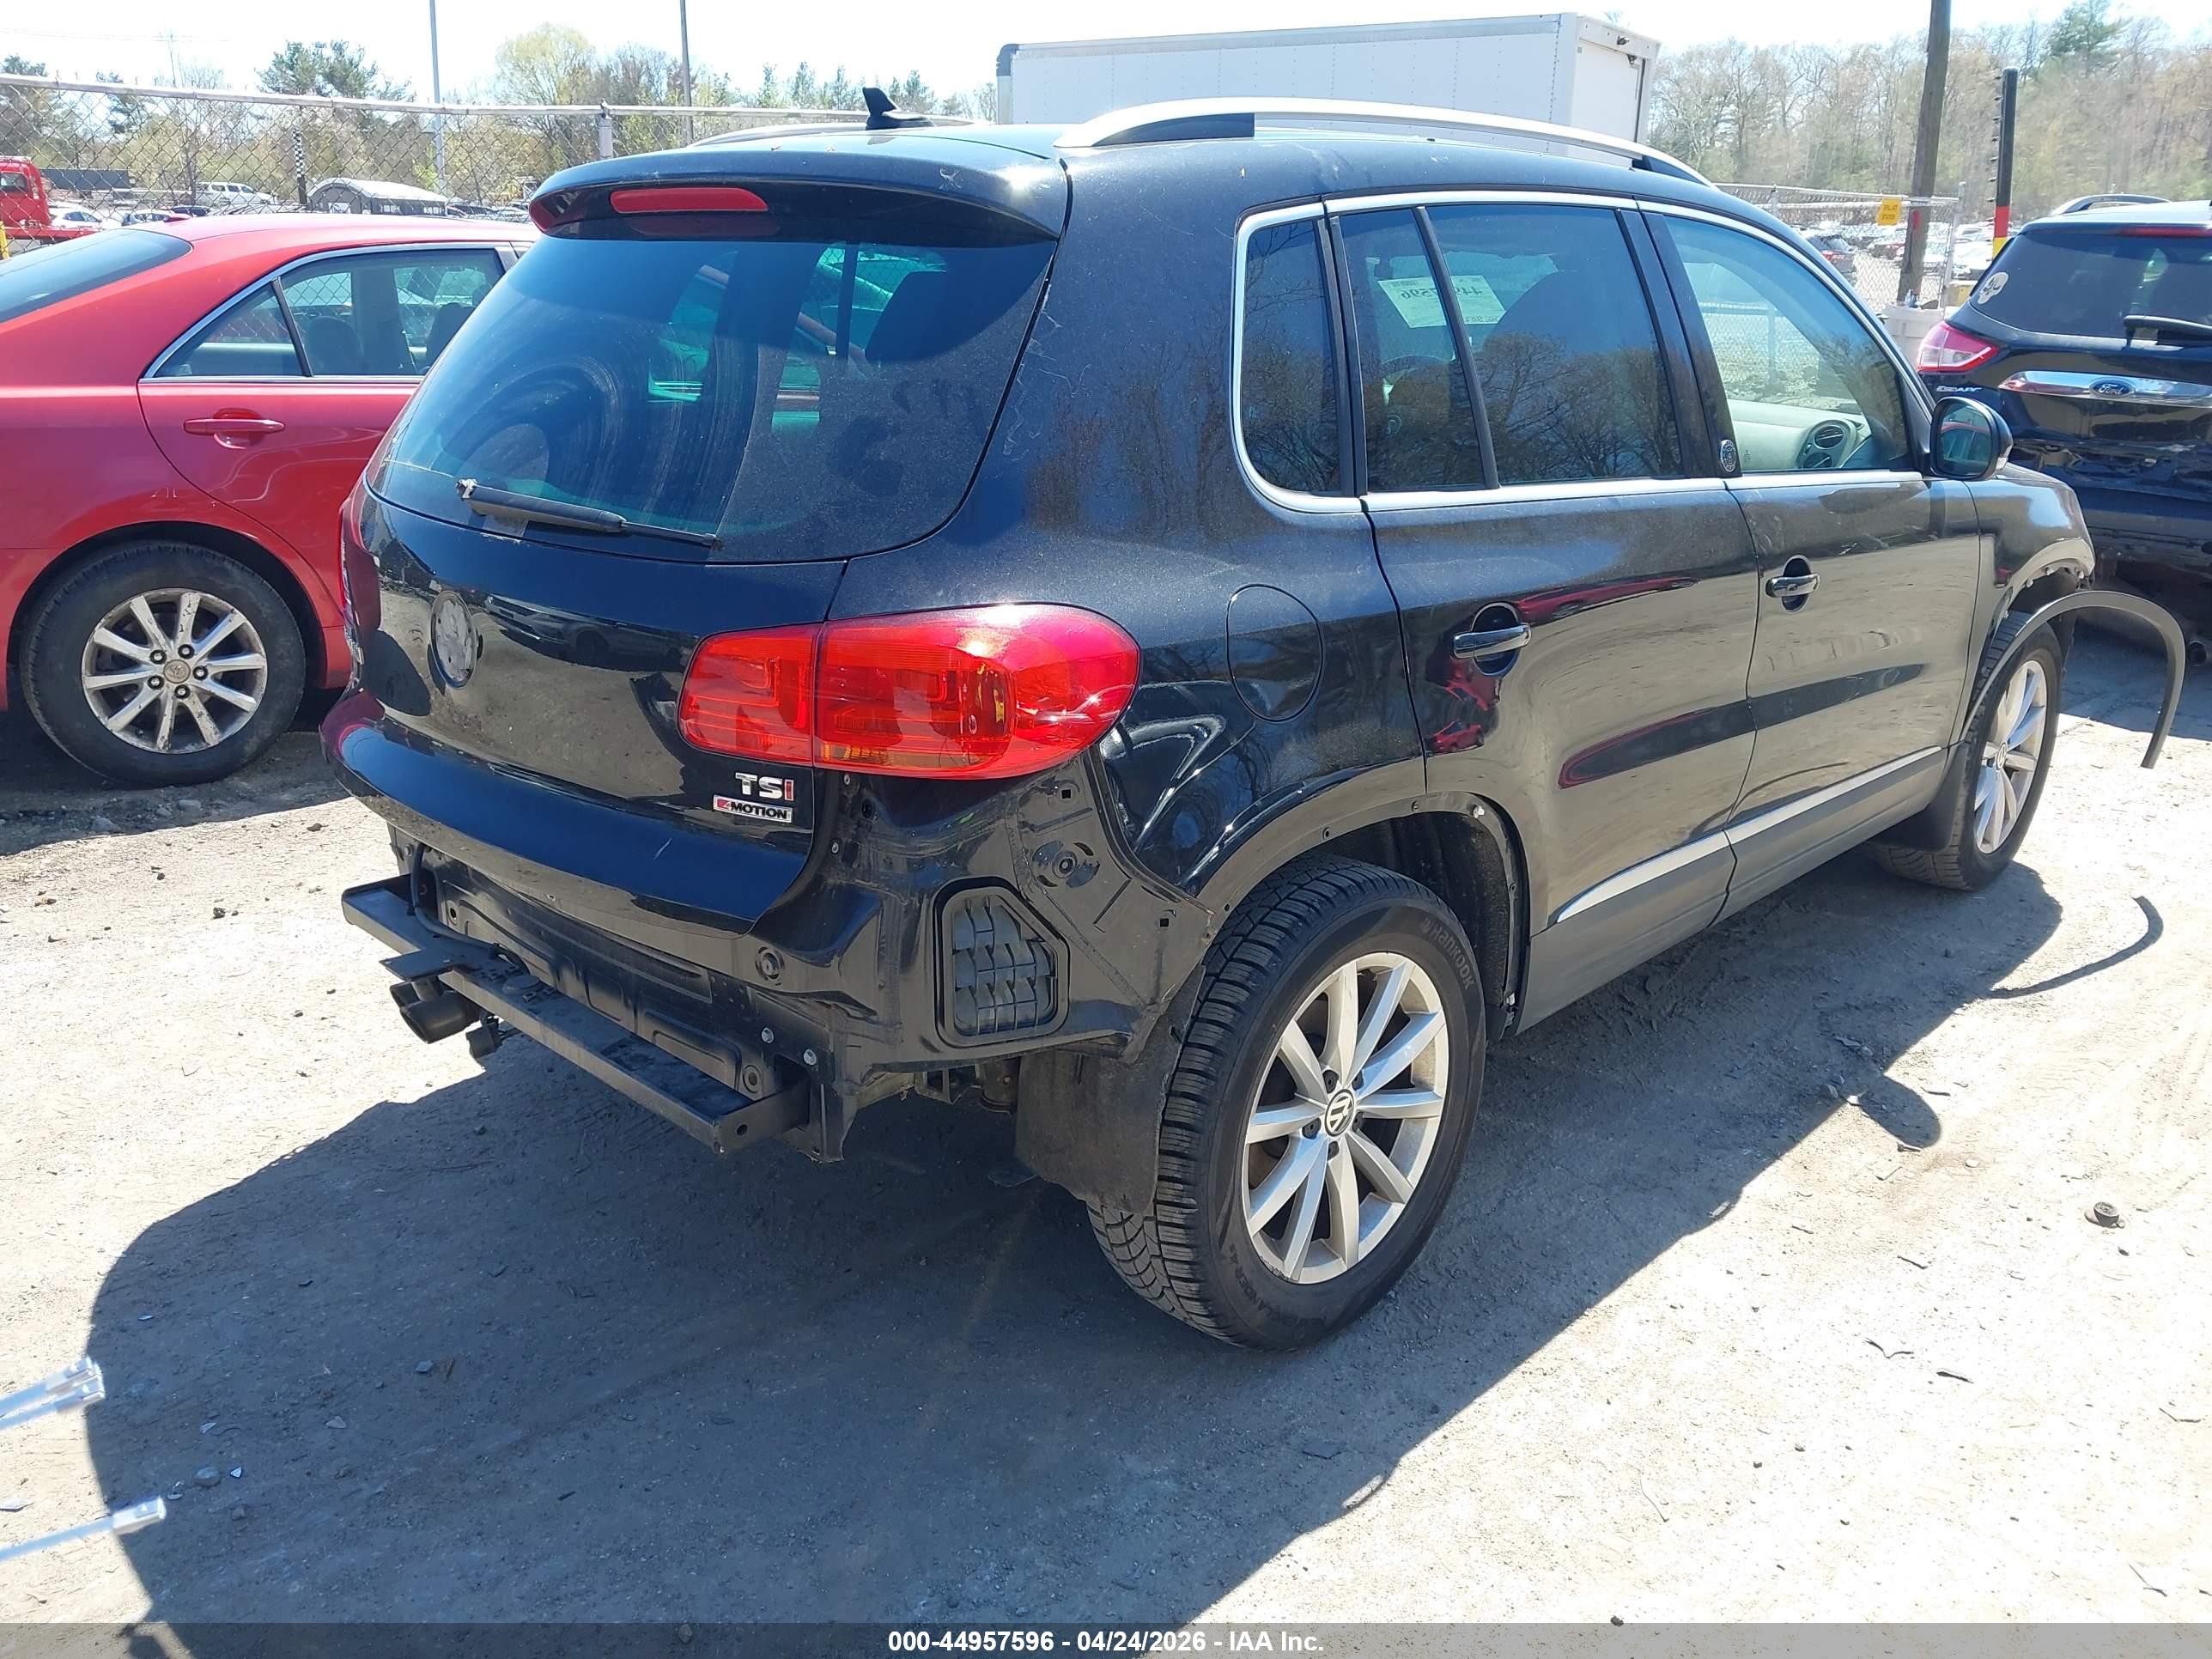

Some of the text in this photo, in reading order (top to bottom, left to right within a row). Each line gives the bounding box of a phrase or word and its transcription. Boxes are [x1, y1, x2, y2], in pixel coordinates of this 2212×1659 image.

[2098, 383, 2123, 395] Ford
[734, 772, 795, 801] TSI
[716, 799, 788, 820] 4MOTION
